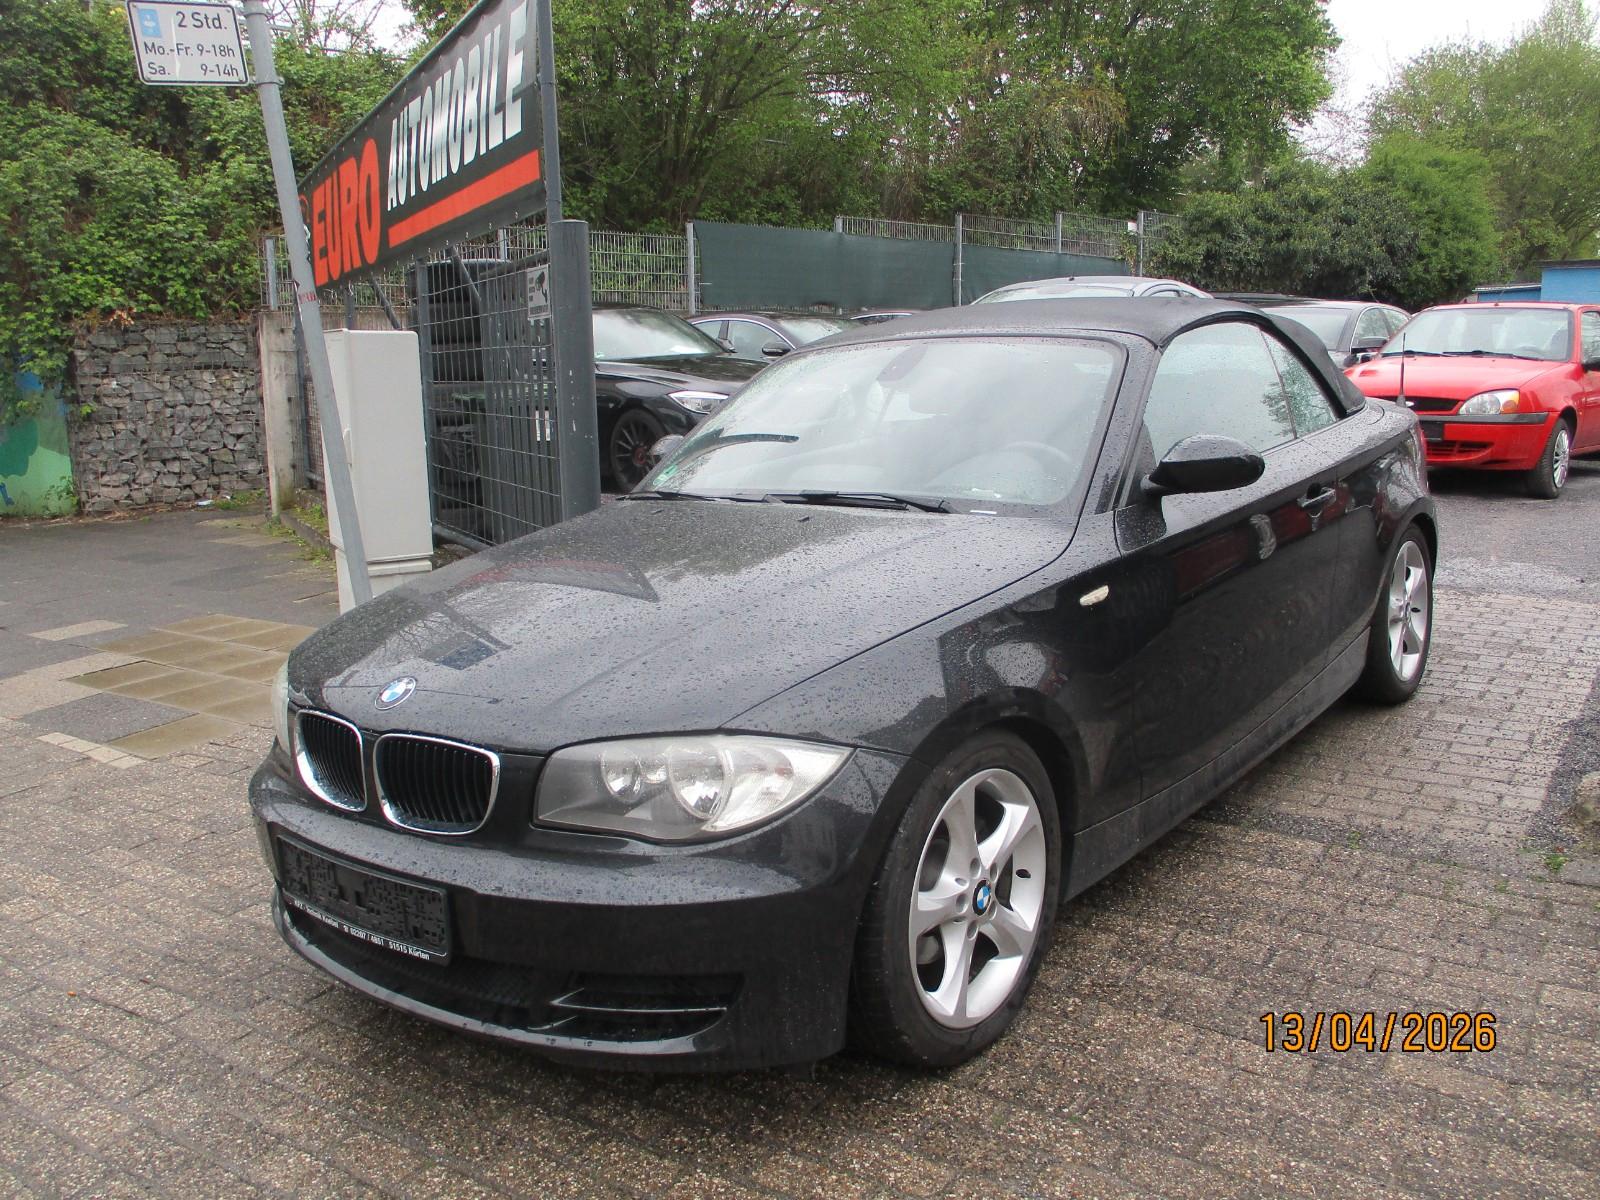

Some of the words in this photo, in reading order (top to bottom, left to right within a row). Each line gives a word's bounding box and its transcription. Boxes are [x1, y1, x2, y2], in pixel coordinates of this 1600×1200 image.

[176, 11, 187, 28] 2
[191, 12, 228, 30] Std.
[144, 42, 194, 57] Mo.-Fr.
[196, 44, 235, 58] 9-18h
[147, 62, 171, 76] Sa.
[200, 64, 239, 77] 9-14h
[312, 138, 381, 287] EURO
[387, 0, 527, 212] AUTOMOBILE
